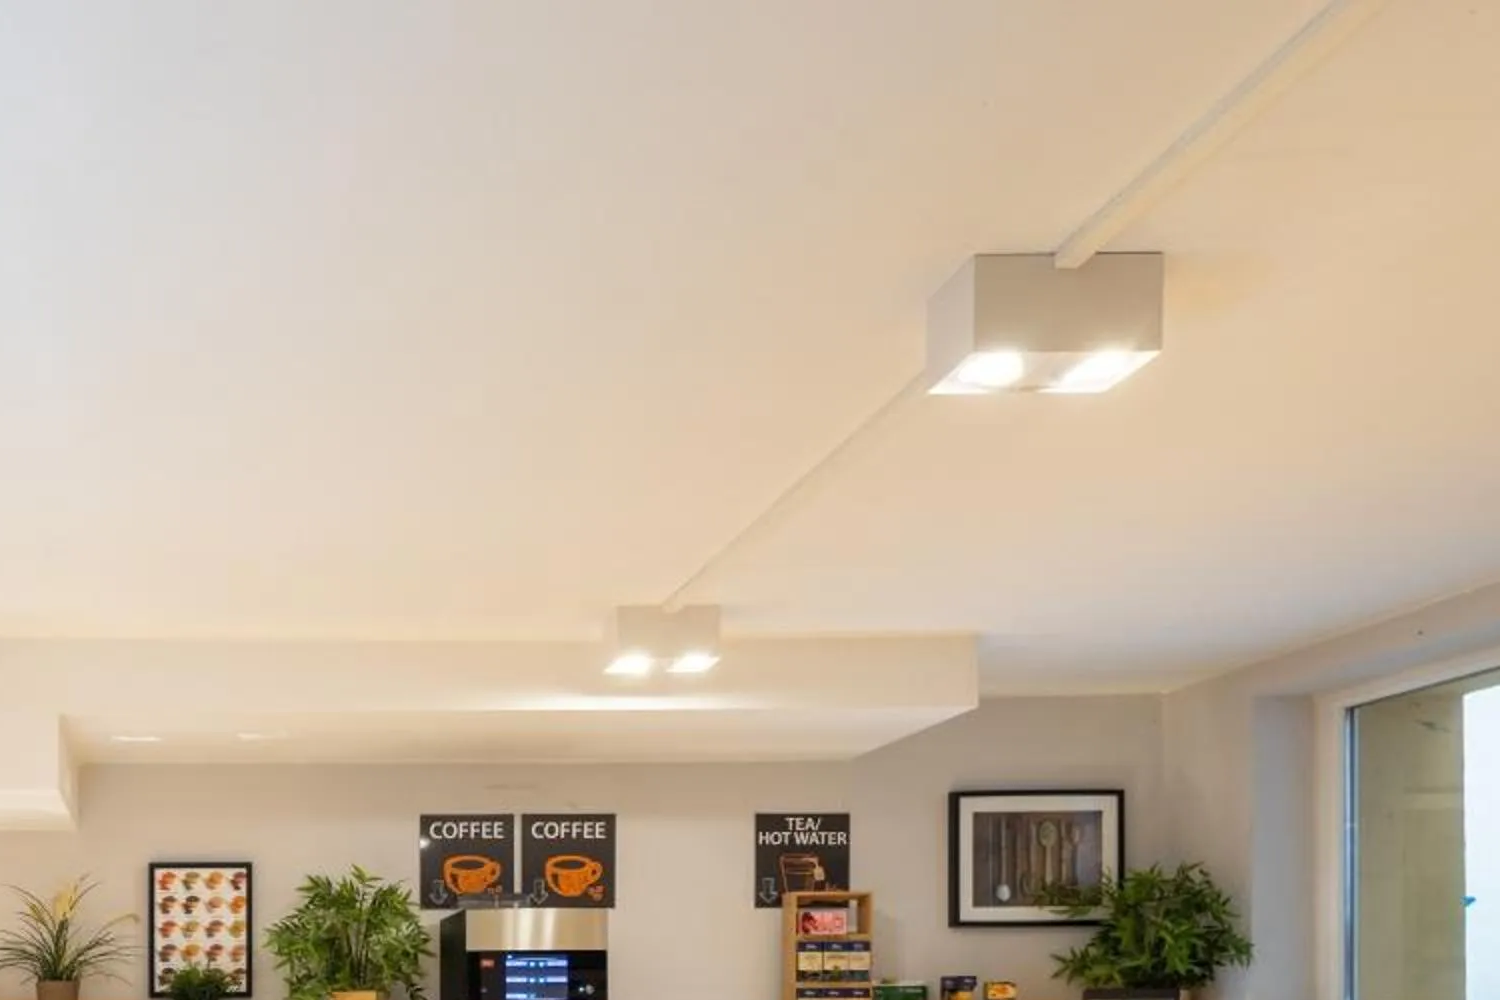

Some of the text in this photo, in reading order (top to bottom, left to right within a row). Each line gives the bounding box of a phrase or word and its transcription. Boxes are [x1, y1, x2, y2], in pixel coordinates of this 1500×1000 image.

[429, 821, 505, 839] COFFEE
[531, 821, 607, 839] COFFEE
[784, 817, 821, 831] TEA/
[759, 831, 847, 845] HOT WATER
